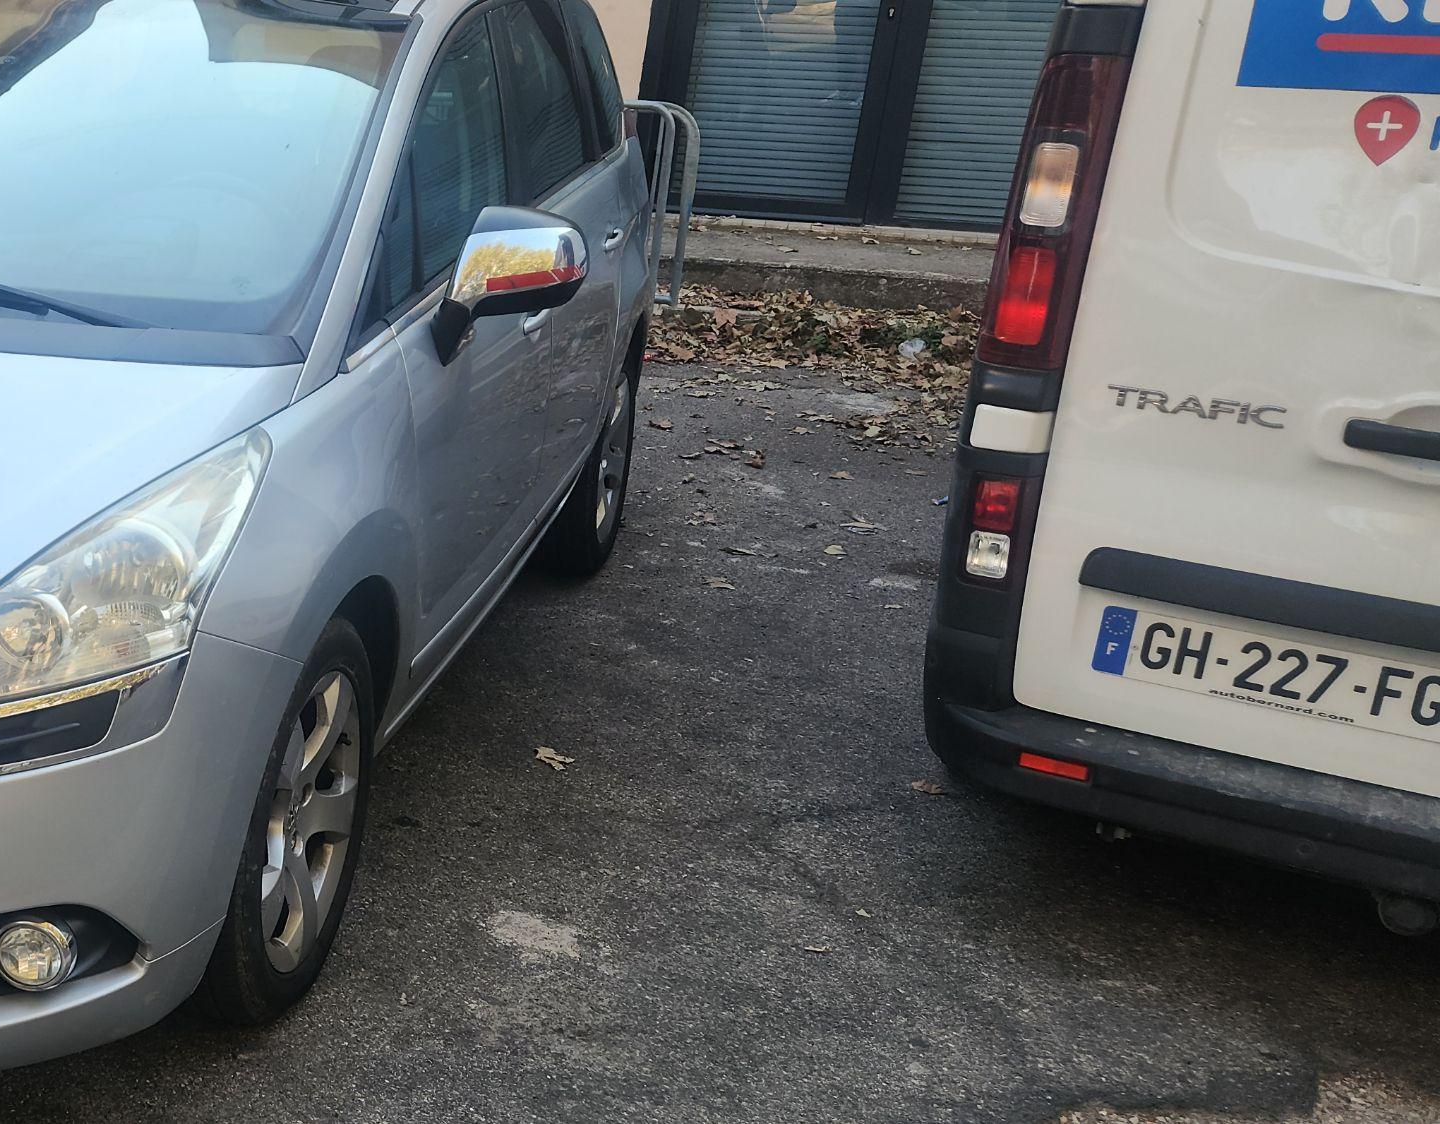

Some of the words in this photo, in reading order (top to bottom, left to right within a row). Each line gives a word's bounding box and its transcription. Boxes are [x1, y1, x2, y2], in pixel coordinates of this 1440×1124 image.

[1107, 384, 1287, 429] TRAFIC
[1106, 642, 1118, 655] F
[1140, 622, 1440, 726] GH-227-FG
[1208, 688, 1355, 723] autobernard.com
